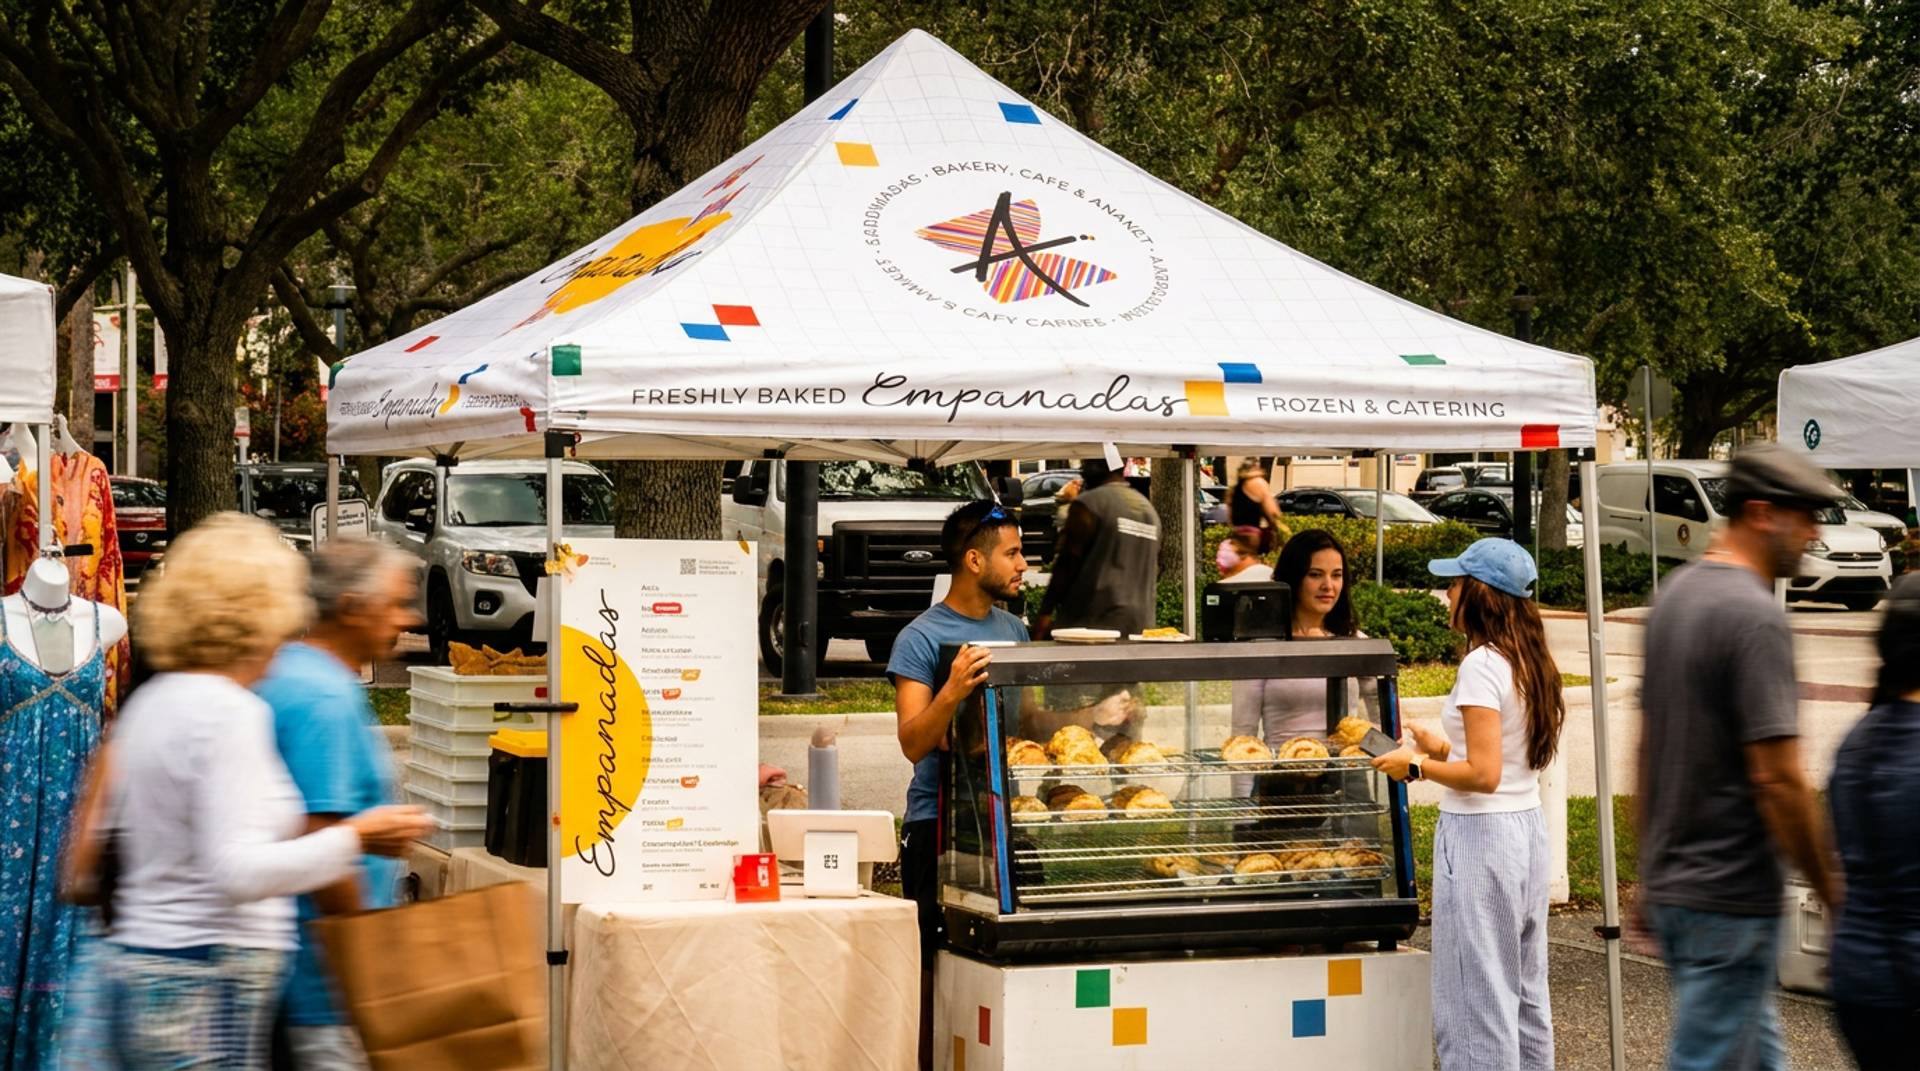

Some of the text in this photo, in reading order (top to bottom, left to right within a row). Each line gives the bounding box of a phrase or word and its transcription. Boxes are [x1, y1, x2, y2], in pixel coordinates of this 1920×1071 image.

[931, 161, 1014, 177] BAKERY,
[1019, 168, 1069, 191] CAFE
[1073, 188, 1086, 199] &
[632, 372, 1506, 423] FRESHLY BAKED Empanadas FROZEN & CATERING
[574, 587, 632, 877] Empanadas
